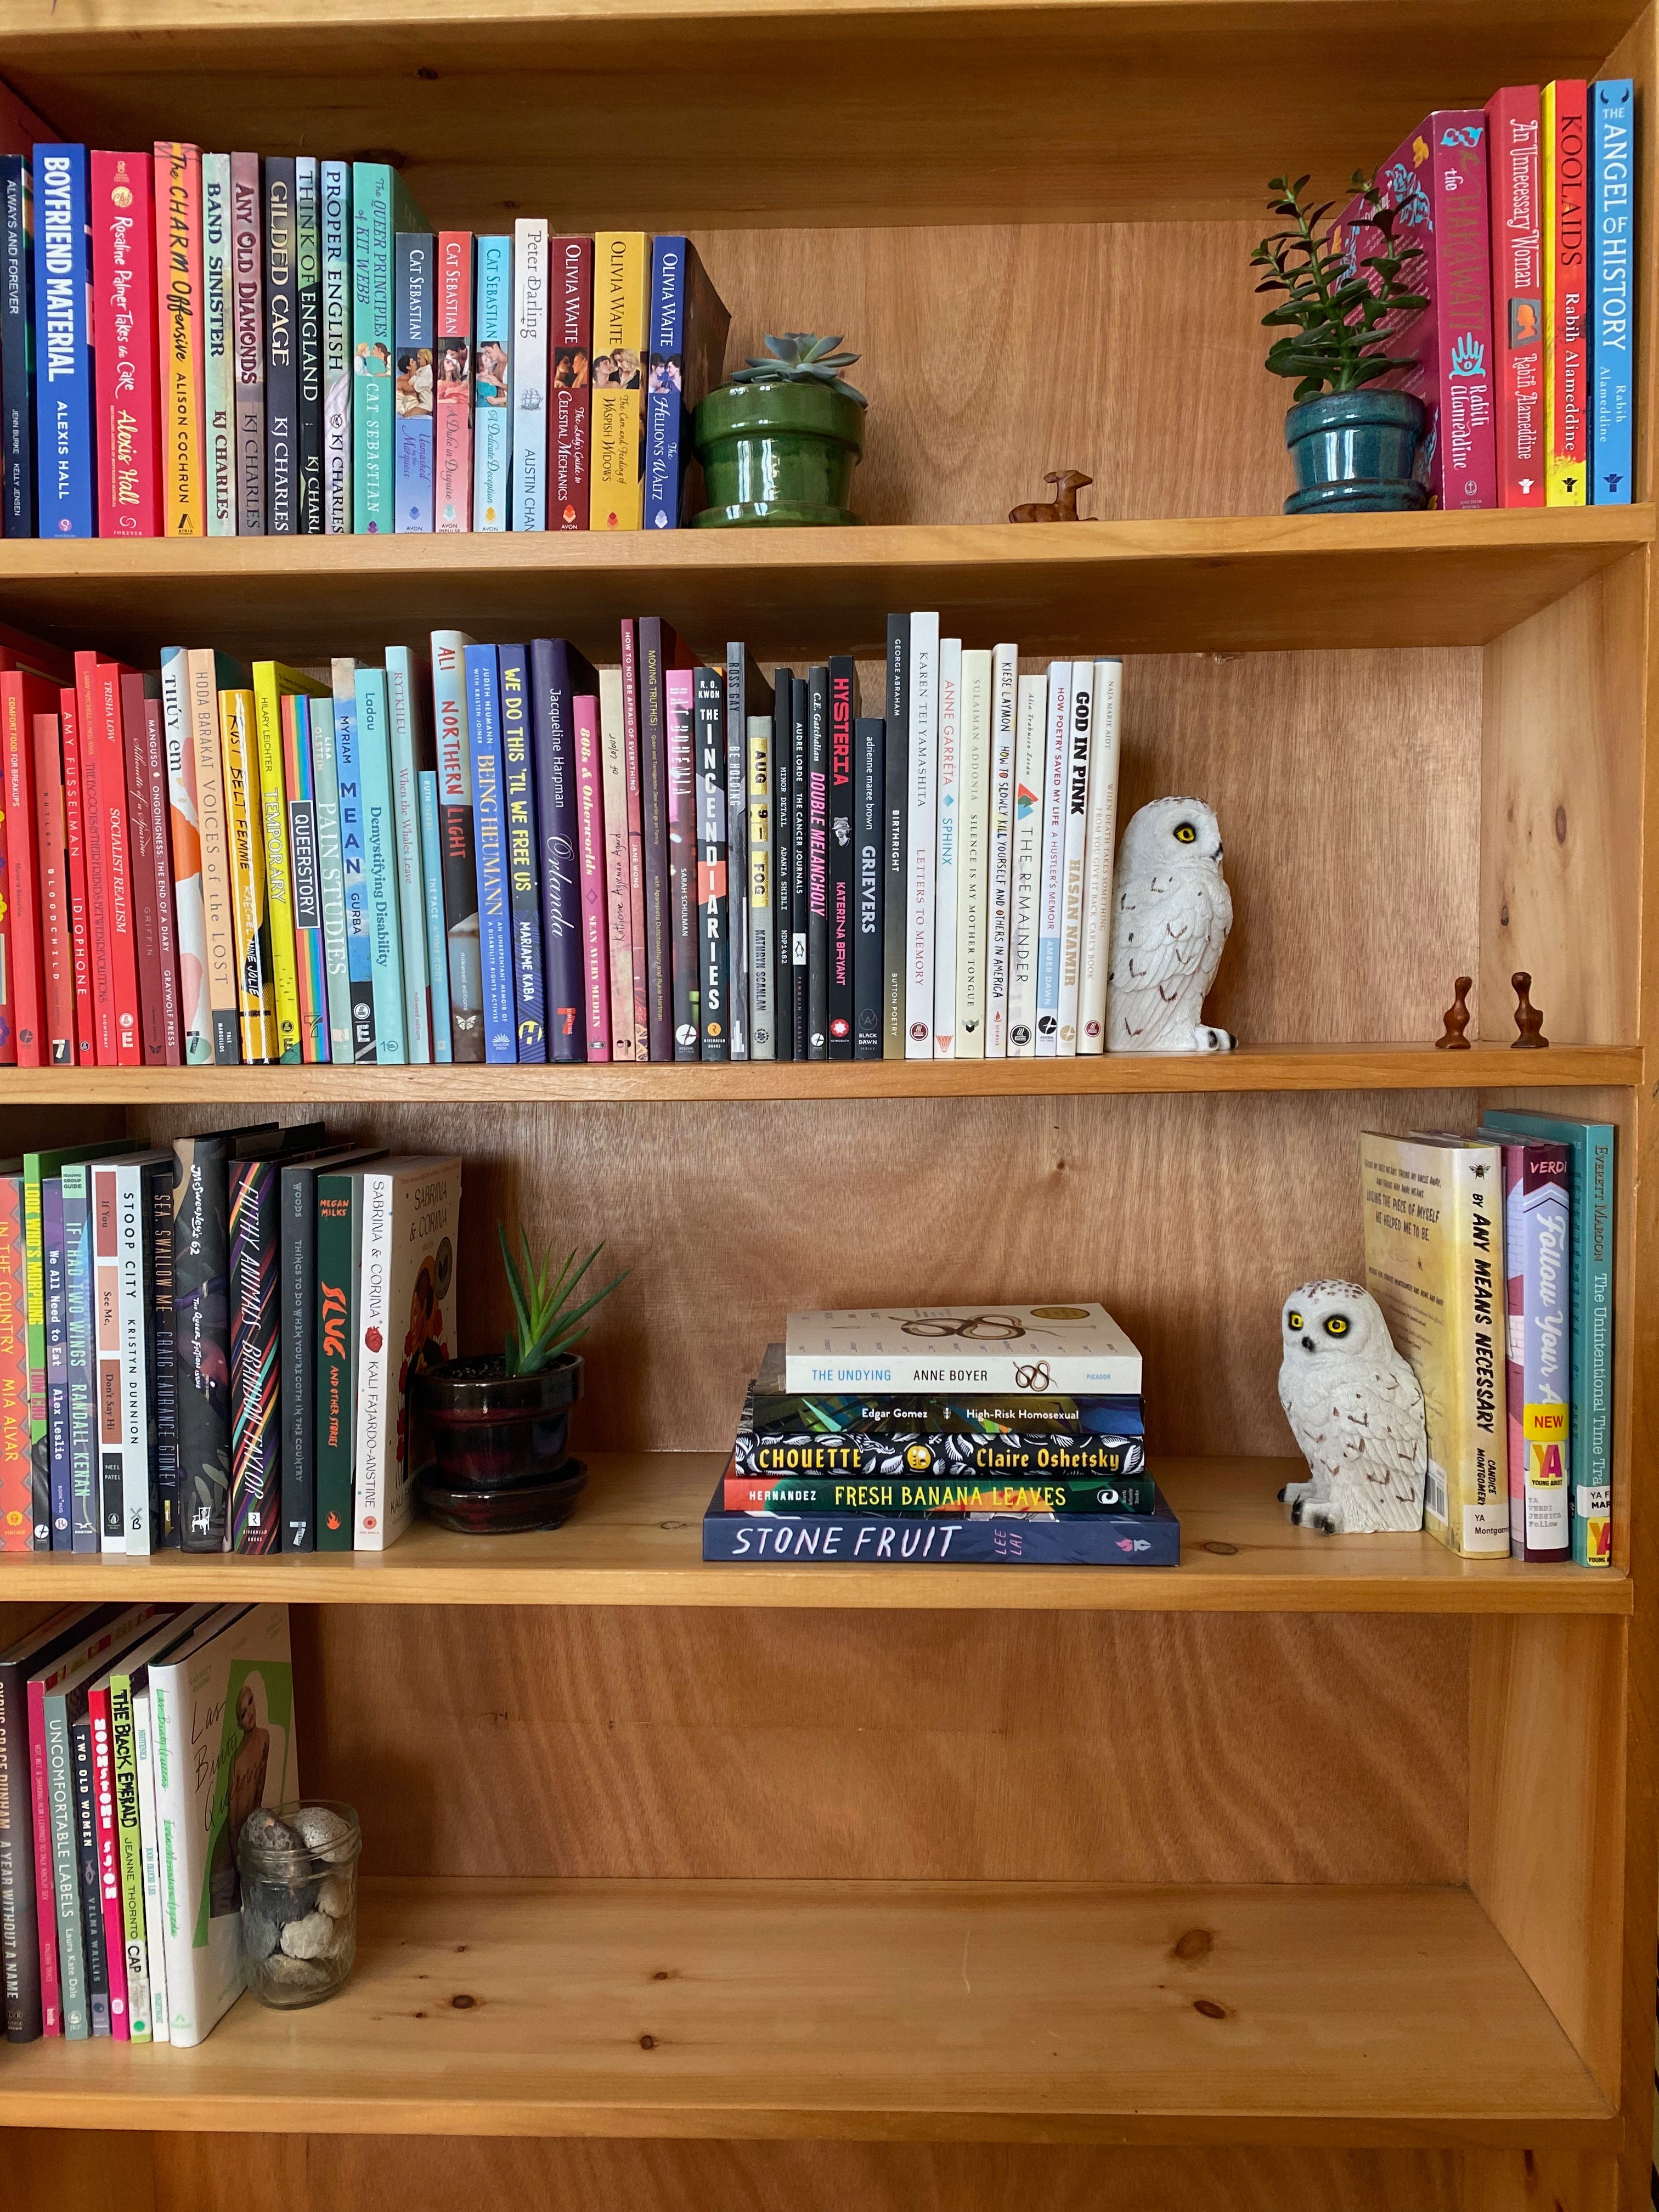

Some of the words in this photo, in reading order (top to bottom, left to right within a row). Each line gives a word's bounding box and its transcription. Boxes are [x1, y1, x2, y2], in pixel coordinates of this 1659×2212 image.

[1510, 119, 1538, 143] An
[1602, 108, 1624, 119] THE
[1507, 144, 1538, 230] Unnecessary
[1561, 115, 1583, 266] KOOLAIDS
[1604, 124, 1627, 212] ANGEL
[44, 157, 72, 273] BOYFRIEND
[207, 182, 222, 244] BAND
[299, 171, 314, 249] THINK
[327, 171, 341, 262] PROPER
[1603, 217, 1628, 234] OF
[301, 256, 315, 284] OF
[610, 241, 627, 292] OLIVIA
[1511, 229, 1539, 288] Woman
[209, 256, 224, 357] SINISTER
[1602, 240, 1627, 351] HISTORY
[47, 278, 74, 382] MATERIAL
[328, 270, 343, 371] ENGLISH
[610, 296, 624, 345] WAITE
[302, 292, 319, 401] ENGLAND
[177, 373, 187, 425] ALISON
[366, 383, 379, 413] CAT
[57, 401, 68, 454] ALEXIS
[59, 461, 69, 499] HALL
[178, 432, 189, 503] COCHRUN
[366, 420, 379, 512] SEBASTIAN
[438, 647, 455, 670] ALI
[504, 668, 521, 691] WE
[626, 653, 631, 663] TO
[165, 675, 182, 729] THÚY
[261, 698, 269, 727] HILARY
[365, 693, 376, 730] Ladau
[506, 698, 522, 720] DO
[627, 685, 632, 694] BE
[944, 680, 955, 719] ANNE
[1075, 692, 1090, 732] GOD
[8, 697, 16, 731] COMFORT
[64, 712, 74, 746] AMY
[484, 701, 493, 744] HEUMANN
[628, 729, 634, 740] OF
[812, 713, 822, 761] Gatchalian
[833, 678, 849, 786] HYSTERIA
[169, 740, 182, 771] em
[263, 730, 272, 771] LEICHTER
[341, 716, 351, 763] MYRIAM
[442, 701, 463, 795] NORTHERN
[506, 727, 524, 763] THIS
[943, 726, 956, 786] GARRÉTA
[1074, 737, 1088, 760] IN
[11, 769, 20, 807] BREAKUPS
[66, 758, 79, 856] FUSSELMAN
[477, 755, 496, 813] BEING
[810, 772, 826, 826] DOUBLE
[1071, 765, 1087, 814] PINK
[319, 802, 339, 859] PAIN
[448, 808, 466, 857] LIGHT
[511, 800, 527, 823] WE
[264, 787, 286, 903] TEMPORARY
[370, 806, 383, 899] Demystifying
[512, 830, 529, 866] FREE
[891, 810, 900, 872] BIRTHRIGHT
[942, 819, 952, 865] SPHINX
[1020, 827, 1033, 863] THE
[295, 814, 314, 916] QUEERSTORY
[481, 816, 503, 916] HEUMANN
[514, 873, 531, 891] US
[548, 833, 574, 937] Orlanda
[811, 828, 825, 916] MELANCHOLY
[862, 845, 876, 933] GRIEVERS
[323, 868, 346, 974] STUDIES
[351, 893, 361, 934] GURBA
[375, 901, 387, 967] Disability
[1017, 873, 1031, 982] REMAINDER
[73, 898, 86, 994] IDIOPHONE
[520, 922, 532, 970] MARIAME
[164, 970, 173, 1018] GRAYWOLF
[522, 974, 534, 1002] KABA
[167, 1021, 175, 1046] PRESS
[1531, 1161, 1567, 1173] VERDI
[101, 1201, 109, 1209] If
[124, 1193, 134, 1249] STOOP
[371, 1182, 383, 1242] SABRINA
[1472, 1193, 1483, 1208] BY
[372, 1249, 381, 1257] &
[1473, 1213, 1492, 1252] ANY
[125, 1261, 136, 1298] CITY
[370, 1263, 382, 1318] CORINA
[1474, 1259, 1492, 1325] MEANS
[3, 1379, 16, 1408] MIA
[369, 1362, 378, 1391] KALI
[812, 1370, 833, 1380] THE
[838, 1370, 891, 1381] UNDYING
[913, 1370, 945, 1381] ANNE
[950, 1370, 988, 1381] BOYER
[1475, 1331, 1497, 1434] NECESSARY
[862, 1408, 890, 1420] Edgar
[894, 1409, 928, 1418] Gomez
[967, 1409, 1015, 1421] High-Risk
[1019, 1410, 1079, 1420] Homosexual
[1534, 1416, 1563, 1428] NEW
[4, 1416, 19, 1462] ALVAR
[364, 1395, 377, 1508] FAJARDO-ANSTINE
[759, 1448, 861, 1468] CHOUETTE
[977, 1448, 1029, 1468] Claire
[1037, 1448, 1120, 1471] Oshetsky
[1532, 1444, 1563, 1478] YA
[749, 1491, 816, 1500] HERNANDEZ
[835, 1487, 893, 1506] FRESH
[902, 1486, 983, 1506] BANANA
[993, 1487, 1066, 1506] LEAVES
[732, 1527, 843, 1555] STONE
[854, 1526, 963, 1558] FRUIT
[995, 1529, 1007, 1555] LEE
[1010, 1534, 1023, 1556] LAI
[112, 1689, 129, 1721] THE
[77, 1734, 86, 1762] TWO
[115, 1723, 132, 1769] BLACK
[79, 1769, 88, 1793] OLD
[118, 1773, 137, 1827] EMERALD
[49, 1719, 69, 1858] UNCOMFORTABLE
[59, 1865, 74, 1918] LABELS
[80, 1801, 92, 1847] WOMEN
